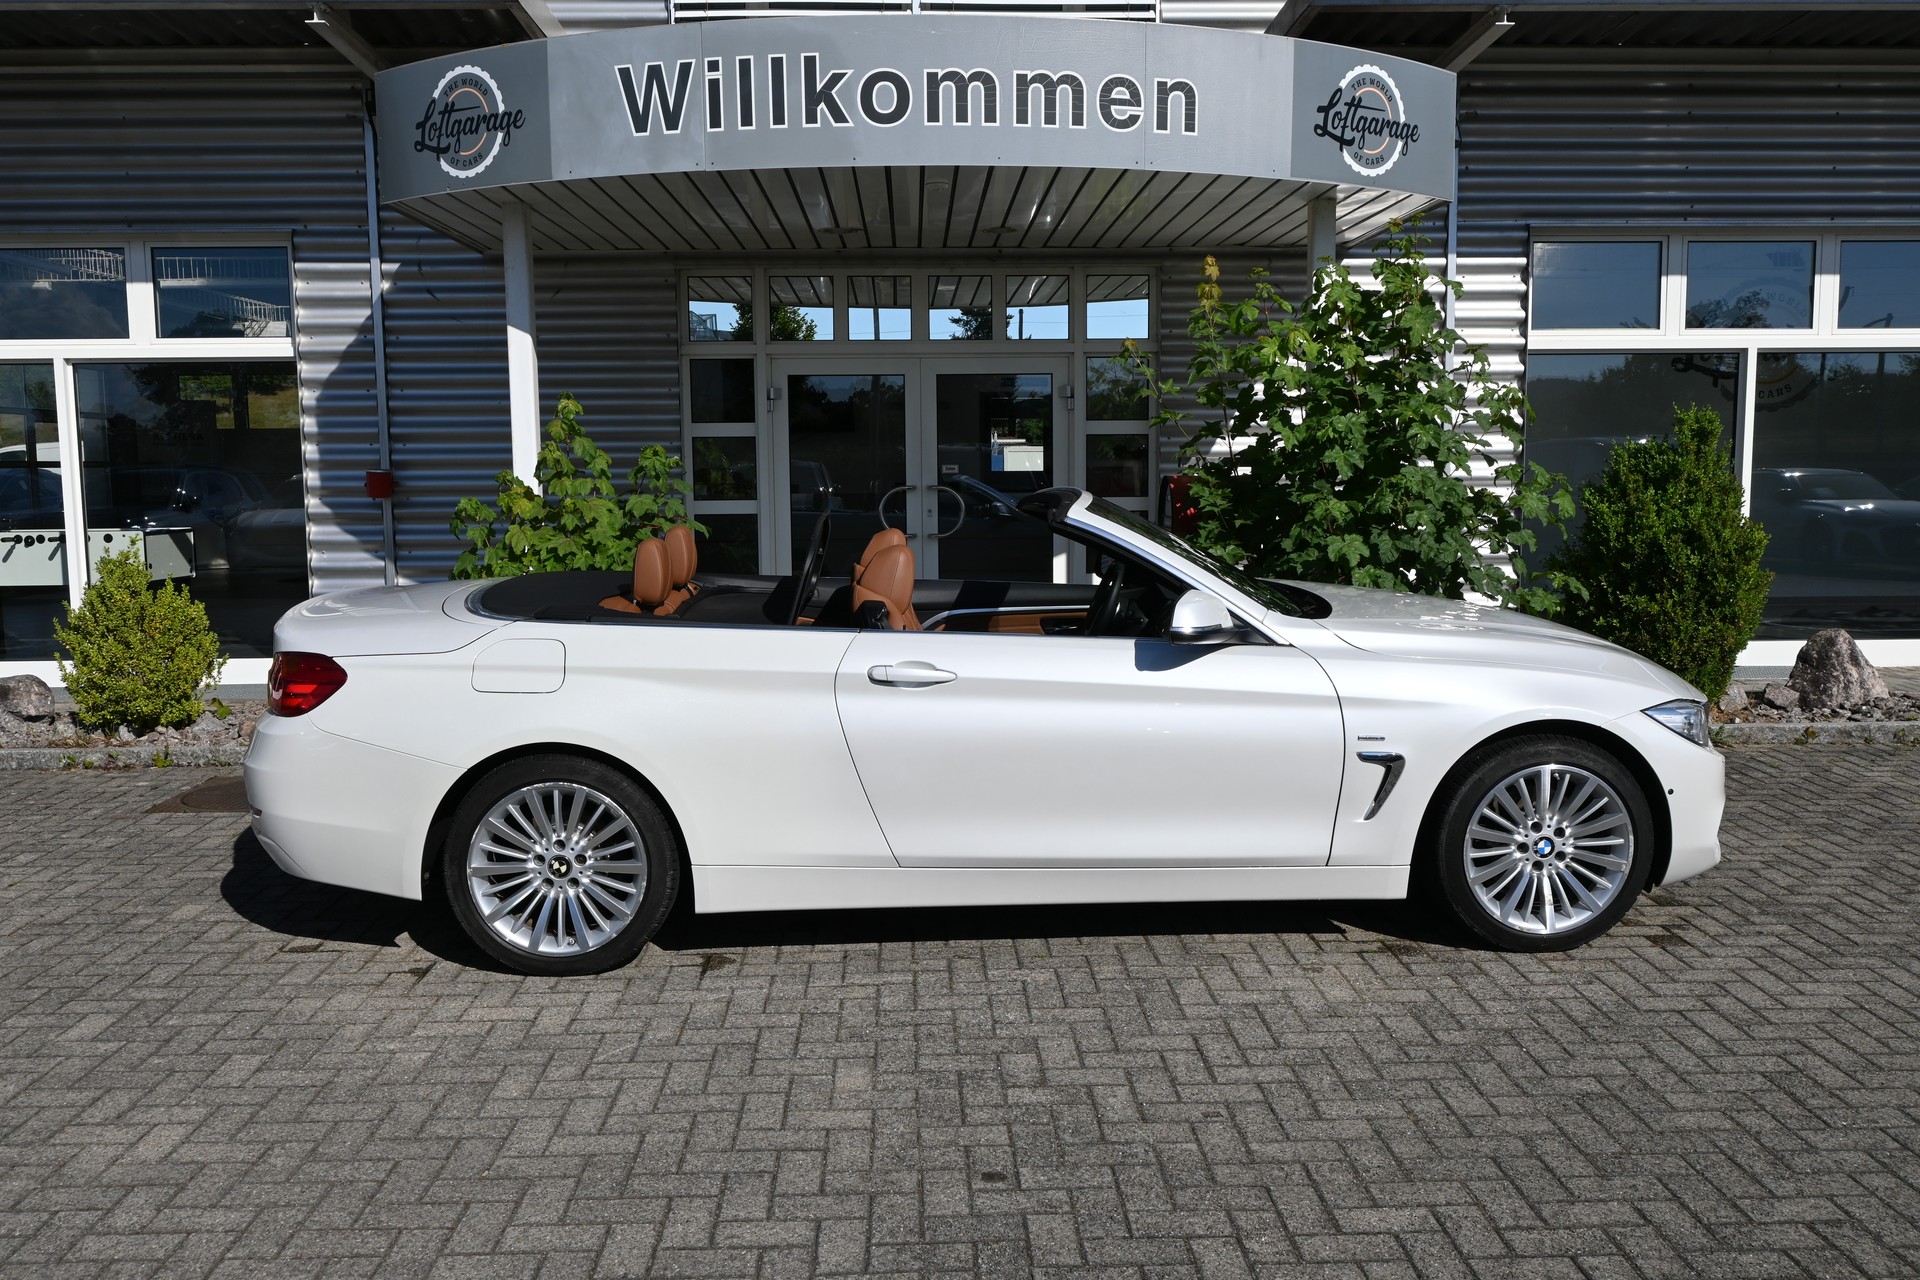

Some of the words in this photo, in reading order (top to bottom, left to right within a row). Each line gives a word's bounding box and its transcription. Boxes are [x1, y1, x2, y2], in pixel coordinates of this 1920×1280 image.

[444, 81, 459, 97] THE
[461, 78, 488, 96] WORLD
[613, 51, 1199, 136] Willkommen
[1351, 78, 1367, 91] THE
[1369, 77, 1393, 103] WORLD
[414, 98, 527, 162] Loftgarage
[1313, 86, 1421, 157] Loftgarage
[451, 157, 460, 167] OF
[463, 153, 483, 167] CARS
[1354, 152, 1364, 162] OF
[1366, 155, 1385, 165] CARS
[1758, 383, 1792, 399] CARS
